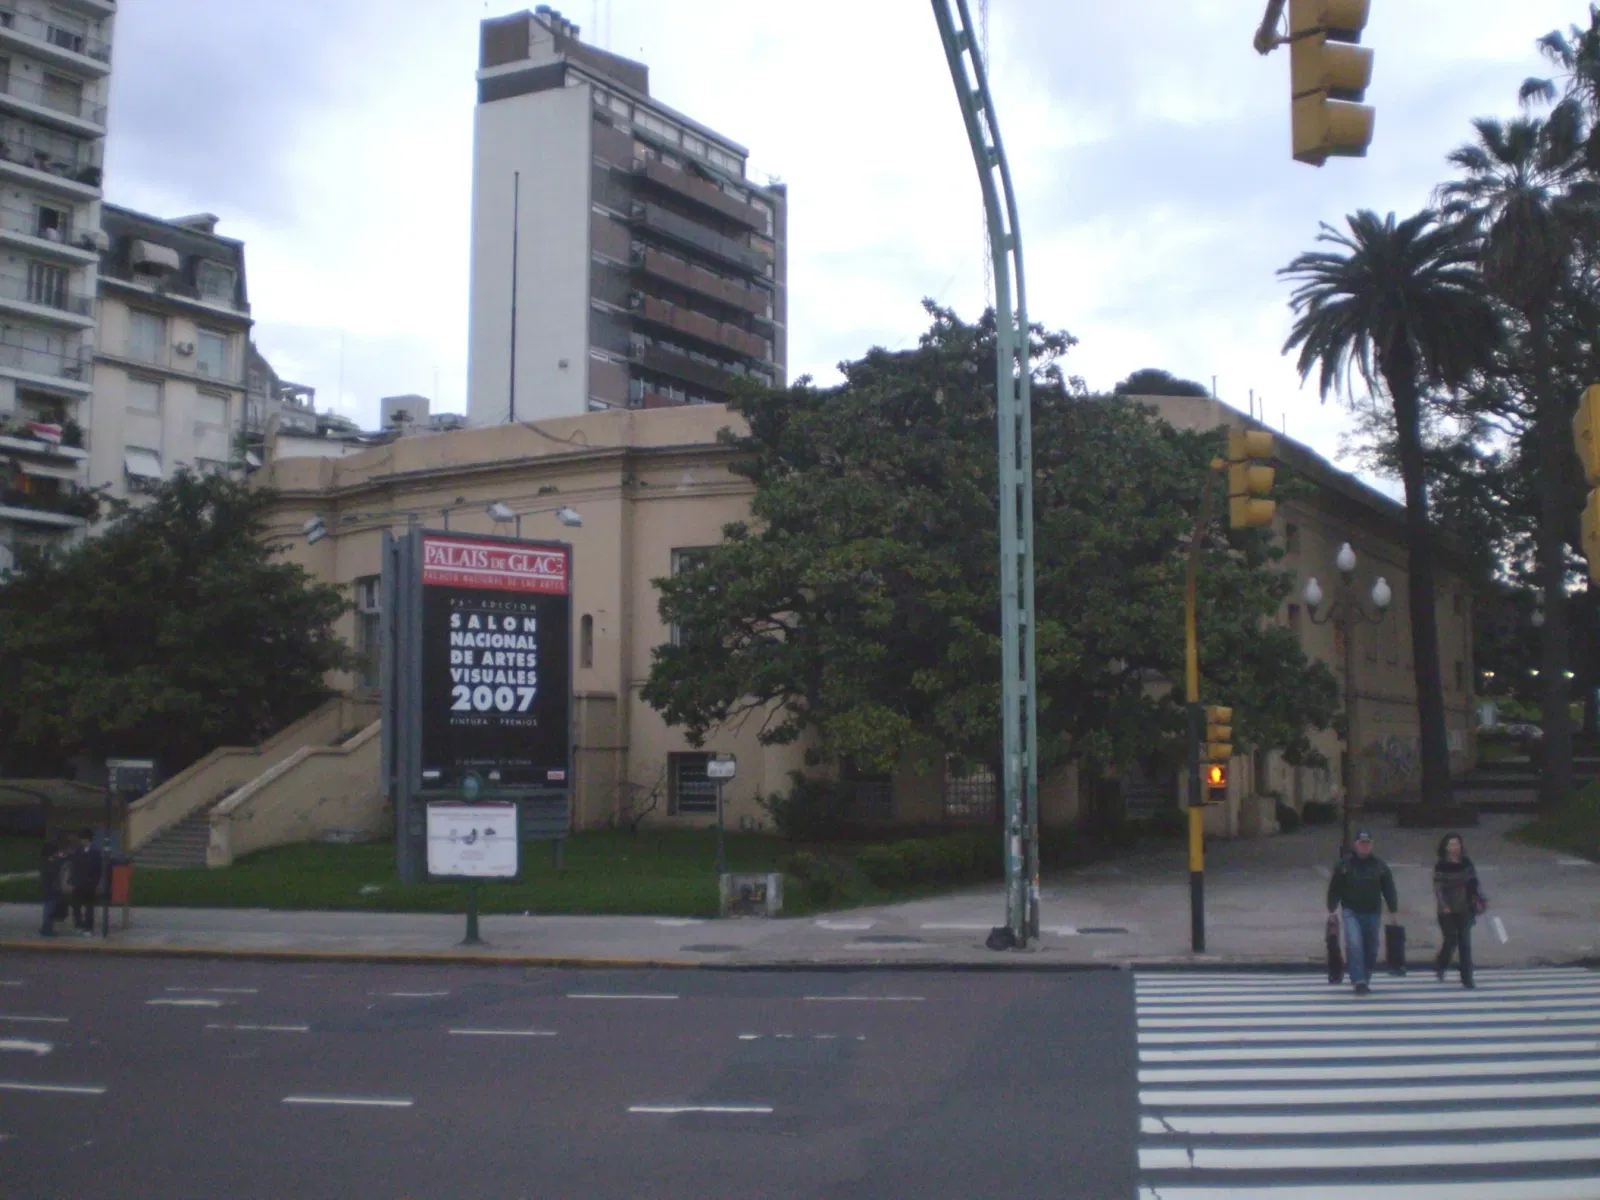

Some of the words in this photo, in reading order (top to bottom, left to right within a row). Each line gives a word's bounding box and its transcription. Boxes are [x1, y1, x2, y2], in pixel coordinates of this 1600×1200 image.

[424, 545, 488, 568] PALAIS
[491, 558, 505, 569] DE
[450, 614, 536, 632] SALON
[450, 631, 537, 650] NACIONAL
[450, 650, 473, 665] DE
[482, 650, 537, 668] ARTES
[450, 668, 537, 685] VISUALES
[450, 685, 537, 711] 2007
